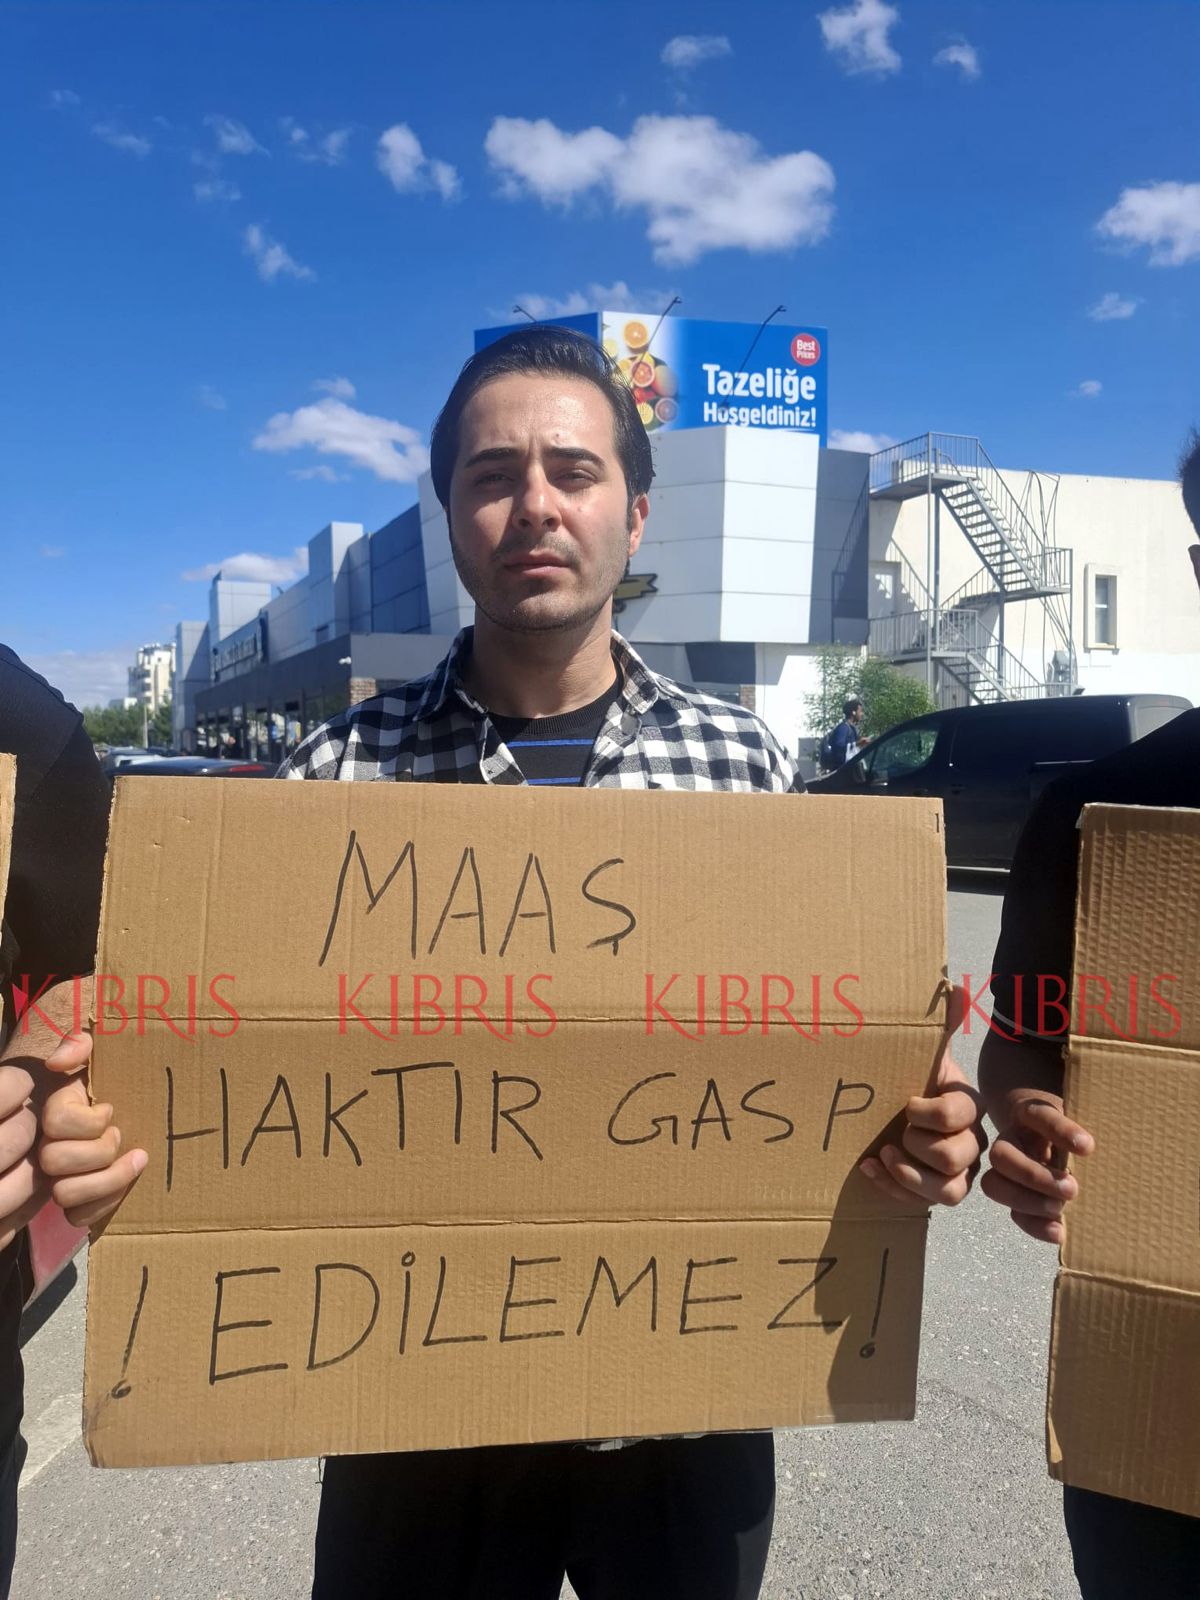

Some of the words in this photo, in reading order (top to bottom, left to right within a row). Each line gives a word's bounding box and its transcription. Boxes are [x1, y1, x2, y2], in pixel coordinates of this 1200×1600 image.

[702, 363, 817, 405] Tazeliğe
[796, 339, 816, 351] Best
[318, 830, 637, 967] MAAŞ
[166, 1061, 545, 1193] HAKTIR
[607, 1072, 875, 1152] GASP
